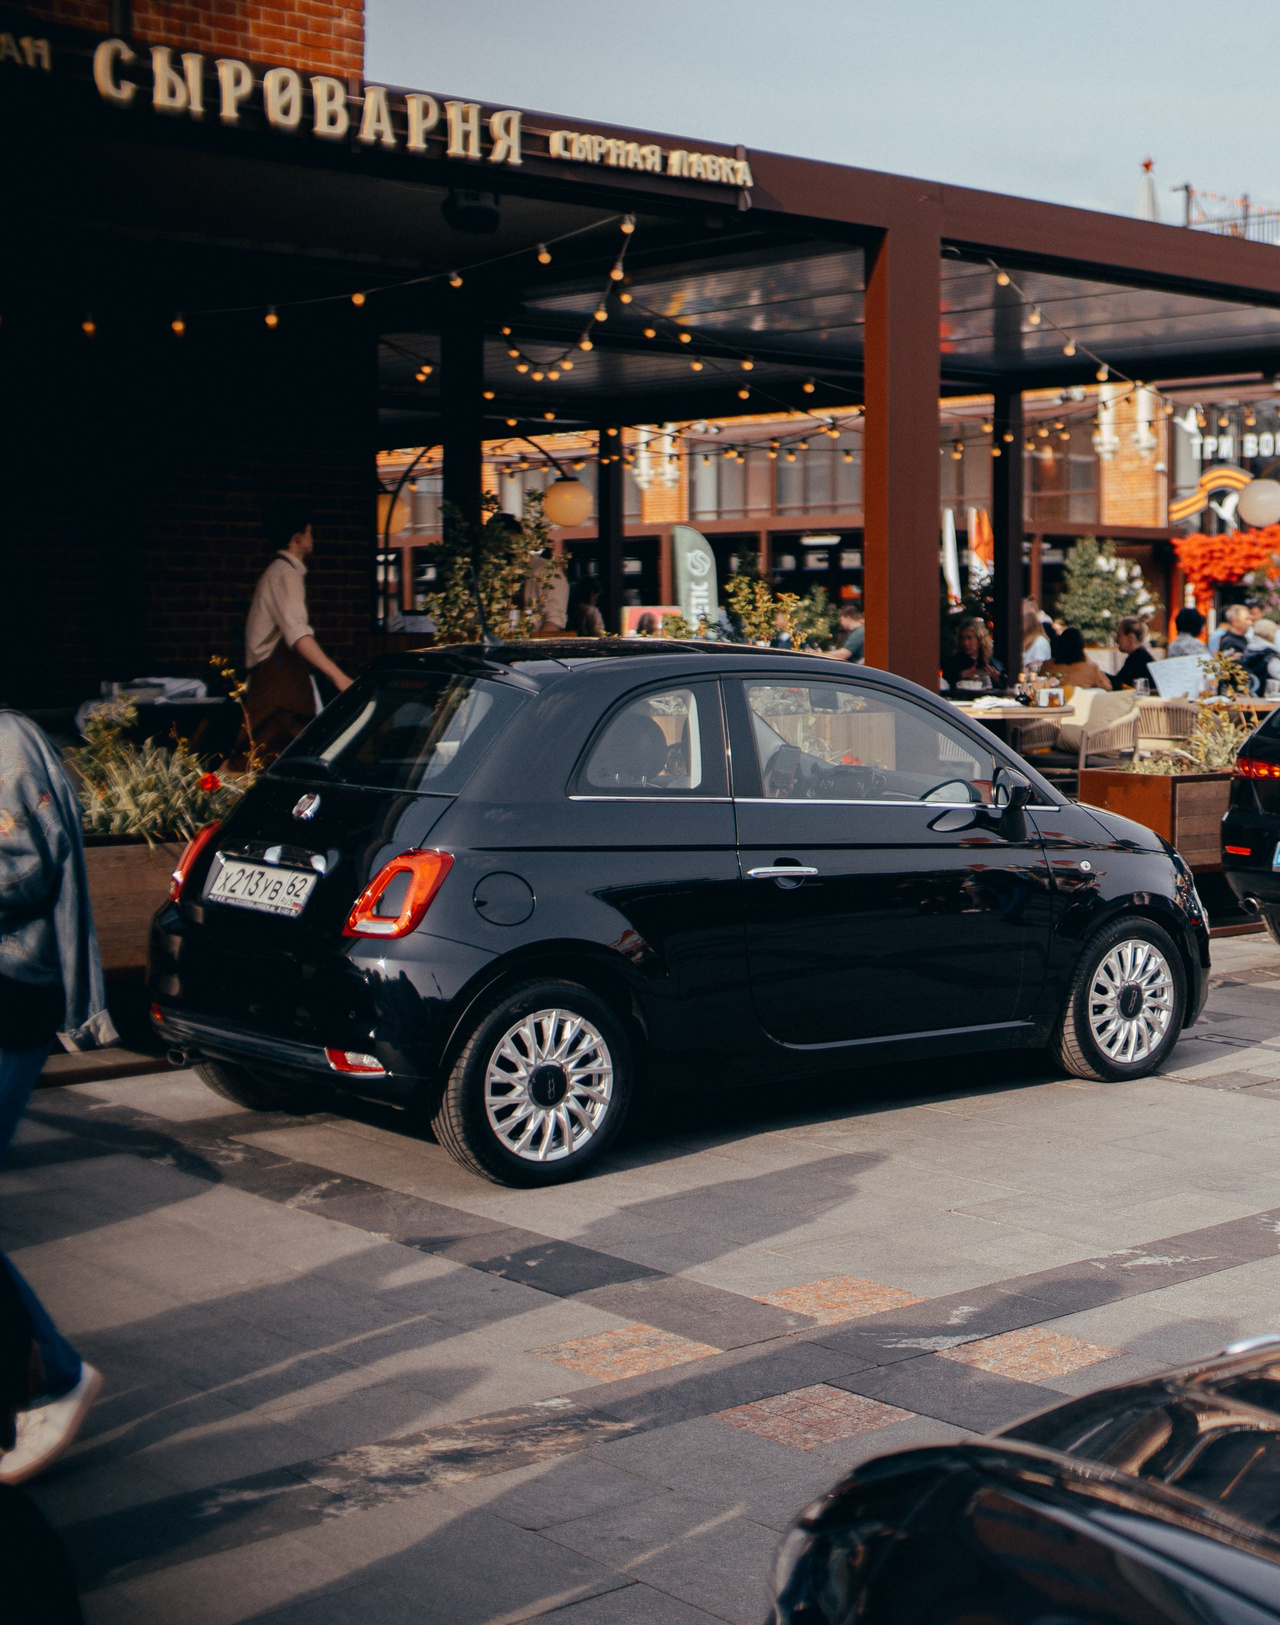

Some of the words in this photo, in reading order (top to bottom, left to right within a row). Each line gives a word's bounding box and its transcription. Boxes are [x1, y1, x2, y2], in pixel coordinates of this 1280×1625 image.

[93, 38, 523, 165] СЫРОВАРНЯ
[550, 129, 662, 173] СЫРНАЯ
[667, 150, 754, 187] ЛАВКА
[1190, 434, 1234, 461] ТРИ
[285, 875, 308, 898] 62
